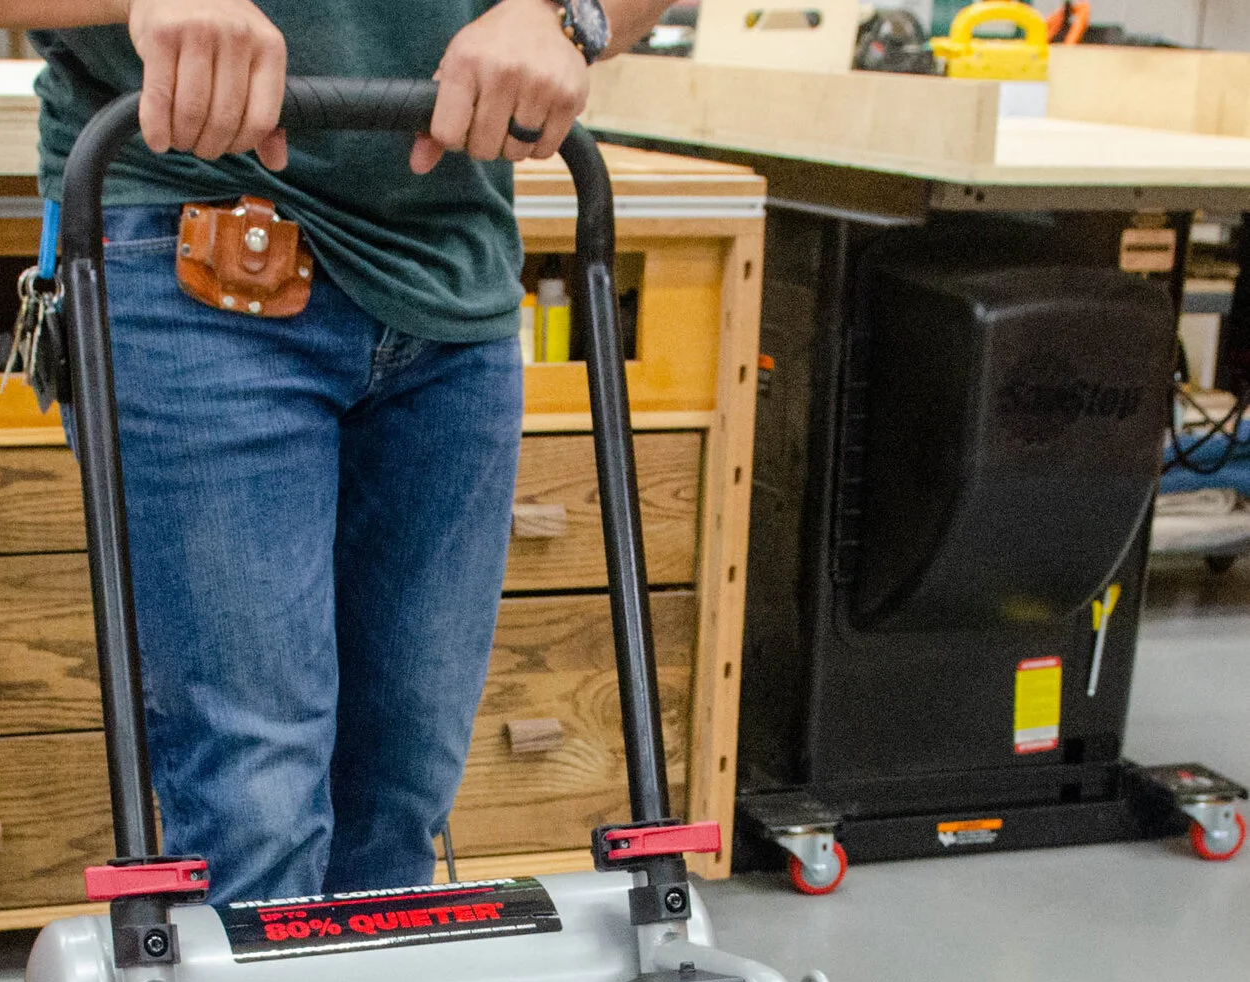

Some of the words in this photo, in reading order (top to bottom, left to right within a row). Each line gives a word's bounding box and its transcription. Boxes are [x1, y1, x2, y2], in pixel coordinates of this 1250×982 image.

[229, 895, 325, 909] SILENT
[333, 877, 516, 900] COMPRESSOR
[260, 913, 282, 922] UP
[284, 911, 307, 919] TO
[264, 918, 342, 941] 80%
